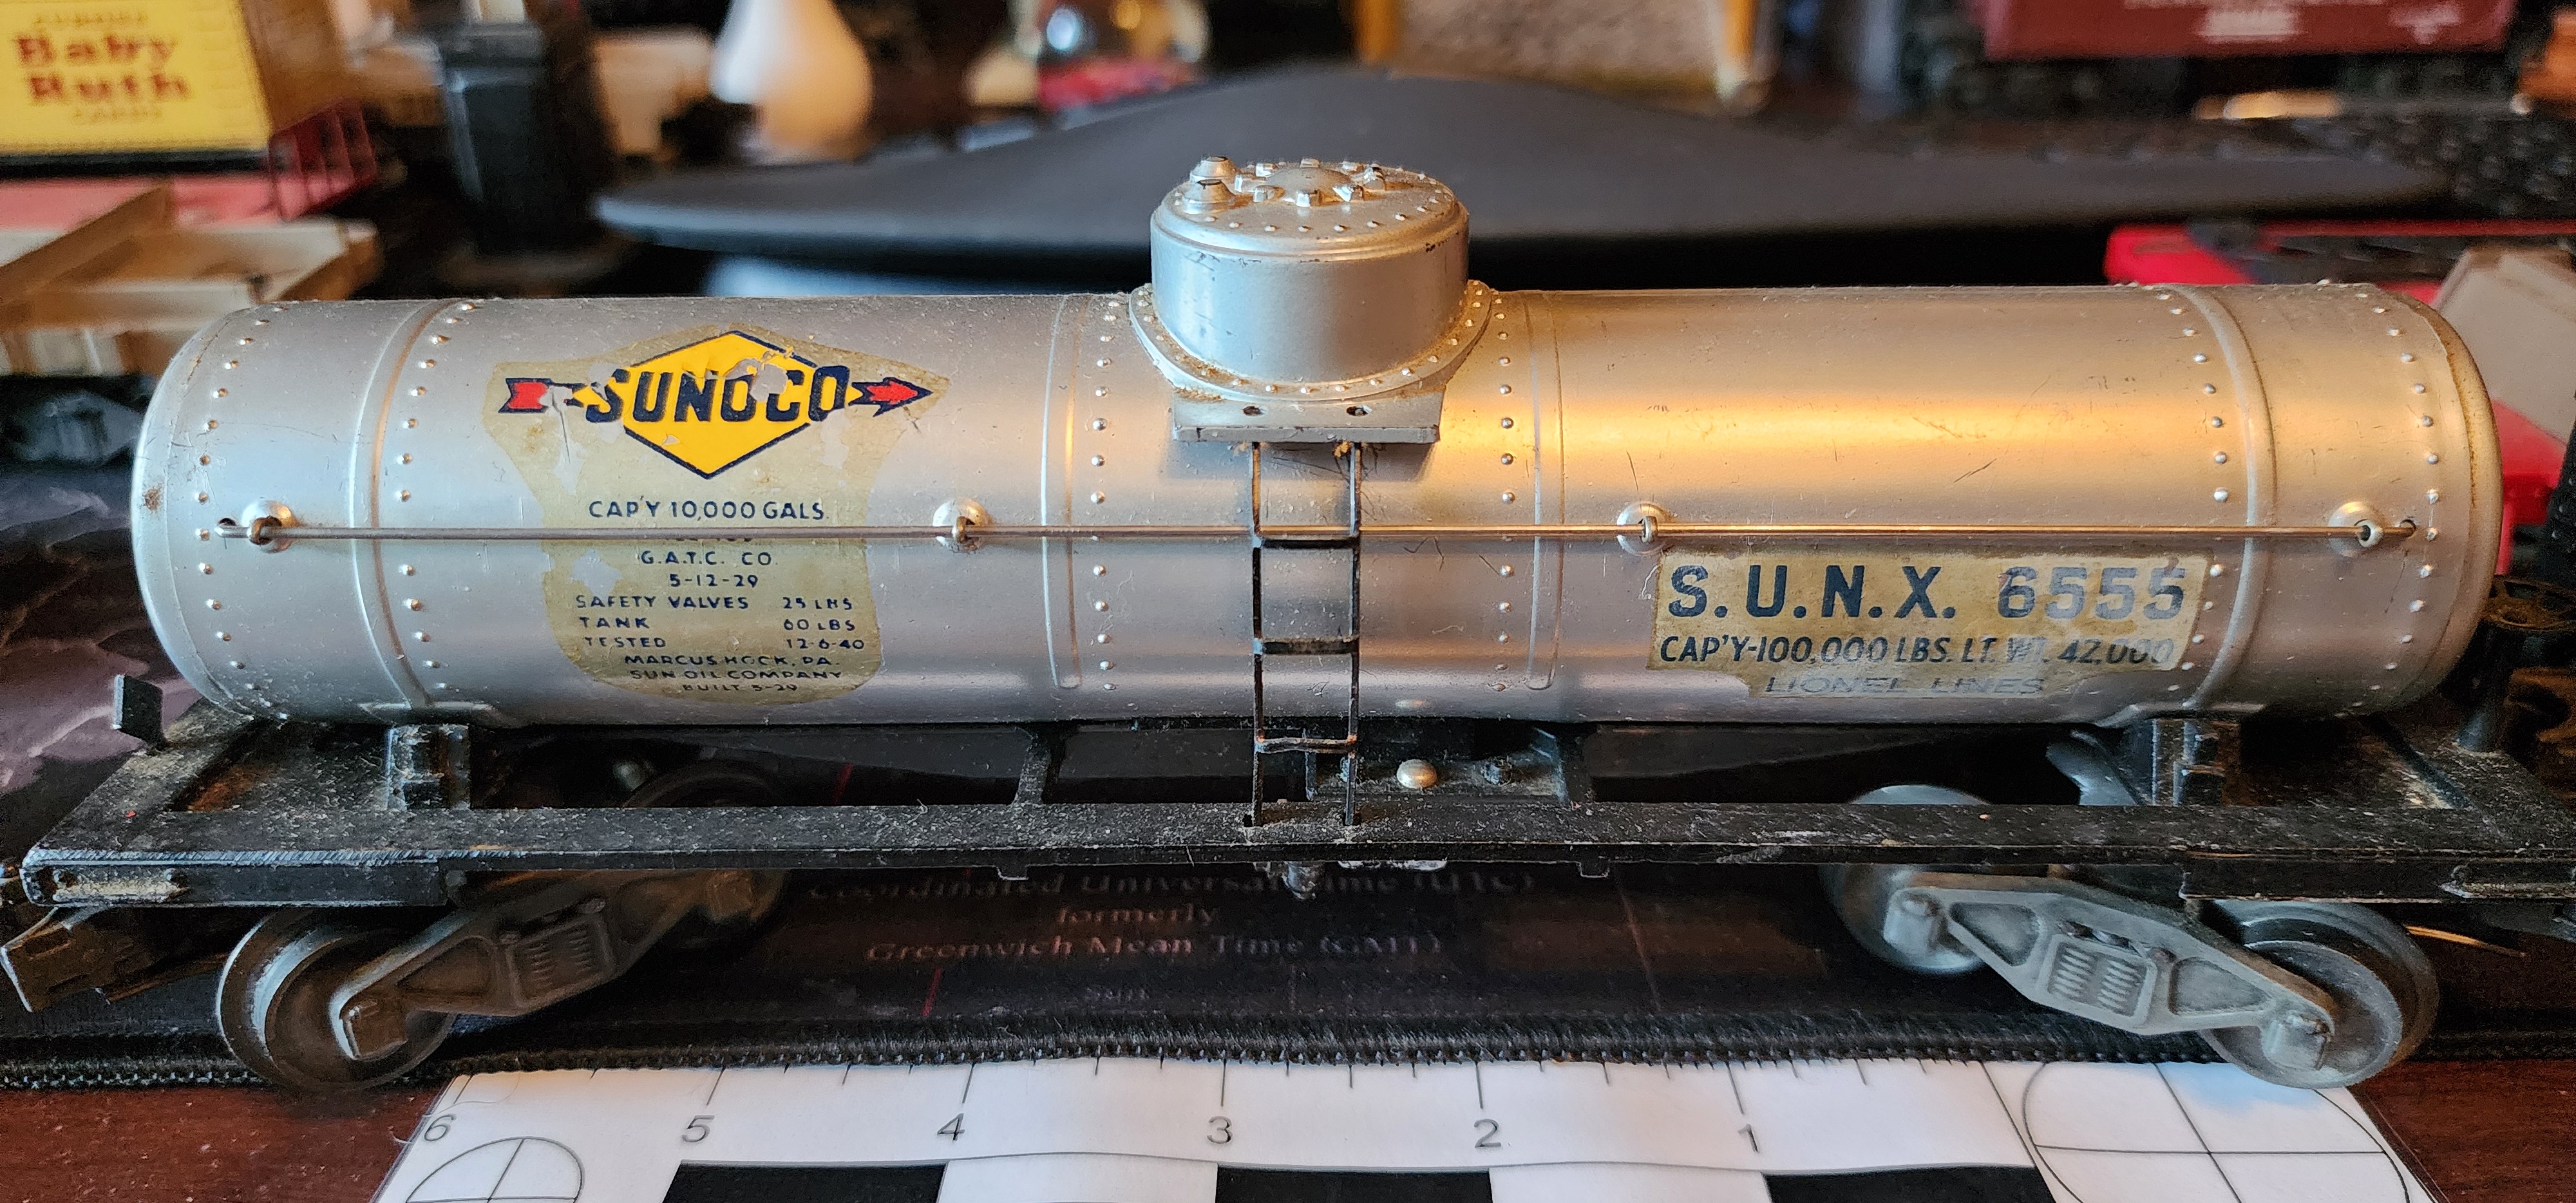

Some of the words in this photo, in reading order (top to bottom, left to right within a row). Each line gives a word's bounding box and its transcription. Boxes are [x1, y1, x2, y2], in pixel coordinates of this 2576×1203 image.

[585, 365, 850, 423] SUNOCO
[670, 500, 755, 522] 10,000
[640, 549, 725, 565] G.A.T.C.
[575, 595, 656, 609] SAFETY
[667, 596, 750, 609] VALVES
[782, 596, 806, 609] 25
[1668, 564, 1956, 619] S.U.N.X.
[1997, 565, 2186, 620] 6555
[579, 616, 650, 629] TANK
[783, 618, 810, 631] 60
[817, 619, 856, 632] LBS
[584, 636, 667, 648] TESTED
[786, 638, 865, 650] 12-6-40
[1893, 636, 1952, 663] LBS.
[1961, 637, 1997, 663] LT.
[624, 655, 718, 665] MARCUS
[629, 669, 677, 679] SUN
[683, 670, 722, 679] OIL
[727, 670, 842, 679] COMPANY
[1765, 676, 1908, 694] LIONEL
[1931, 677, 2046, 695] LINES
[1056, 906, 1221, 927] formerly
[866, 934, 1073, 962] Greenwich
[1088, 935, 1193, 956] Mean
[1211, 934, 1304, 956] Time
[423, 1113, 457, 1142] 6
[681, 1114, 715, 1143] 5
[936, 1112, 965, 1141] 4
[1206, 1115, 1233, 1144] 3
[1473, 1119, 1502, 1149] 2
[1737, 1123, 1759, 1153] 1
